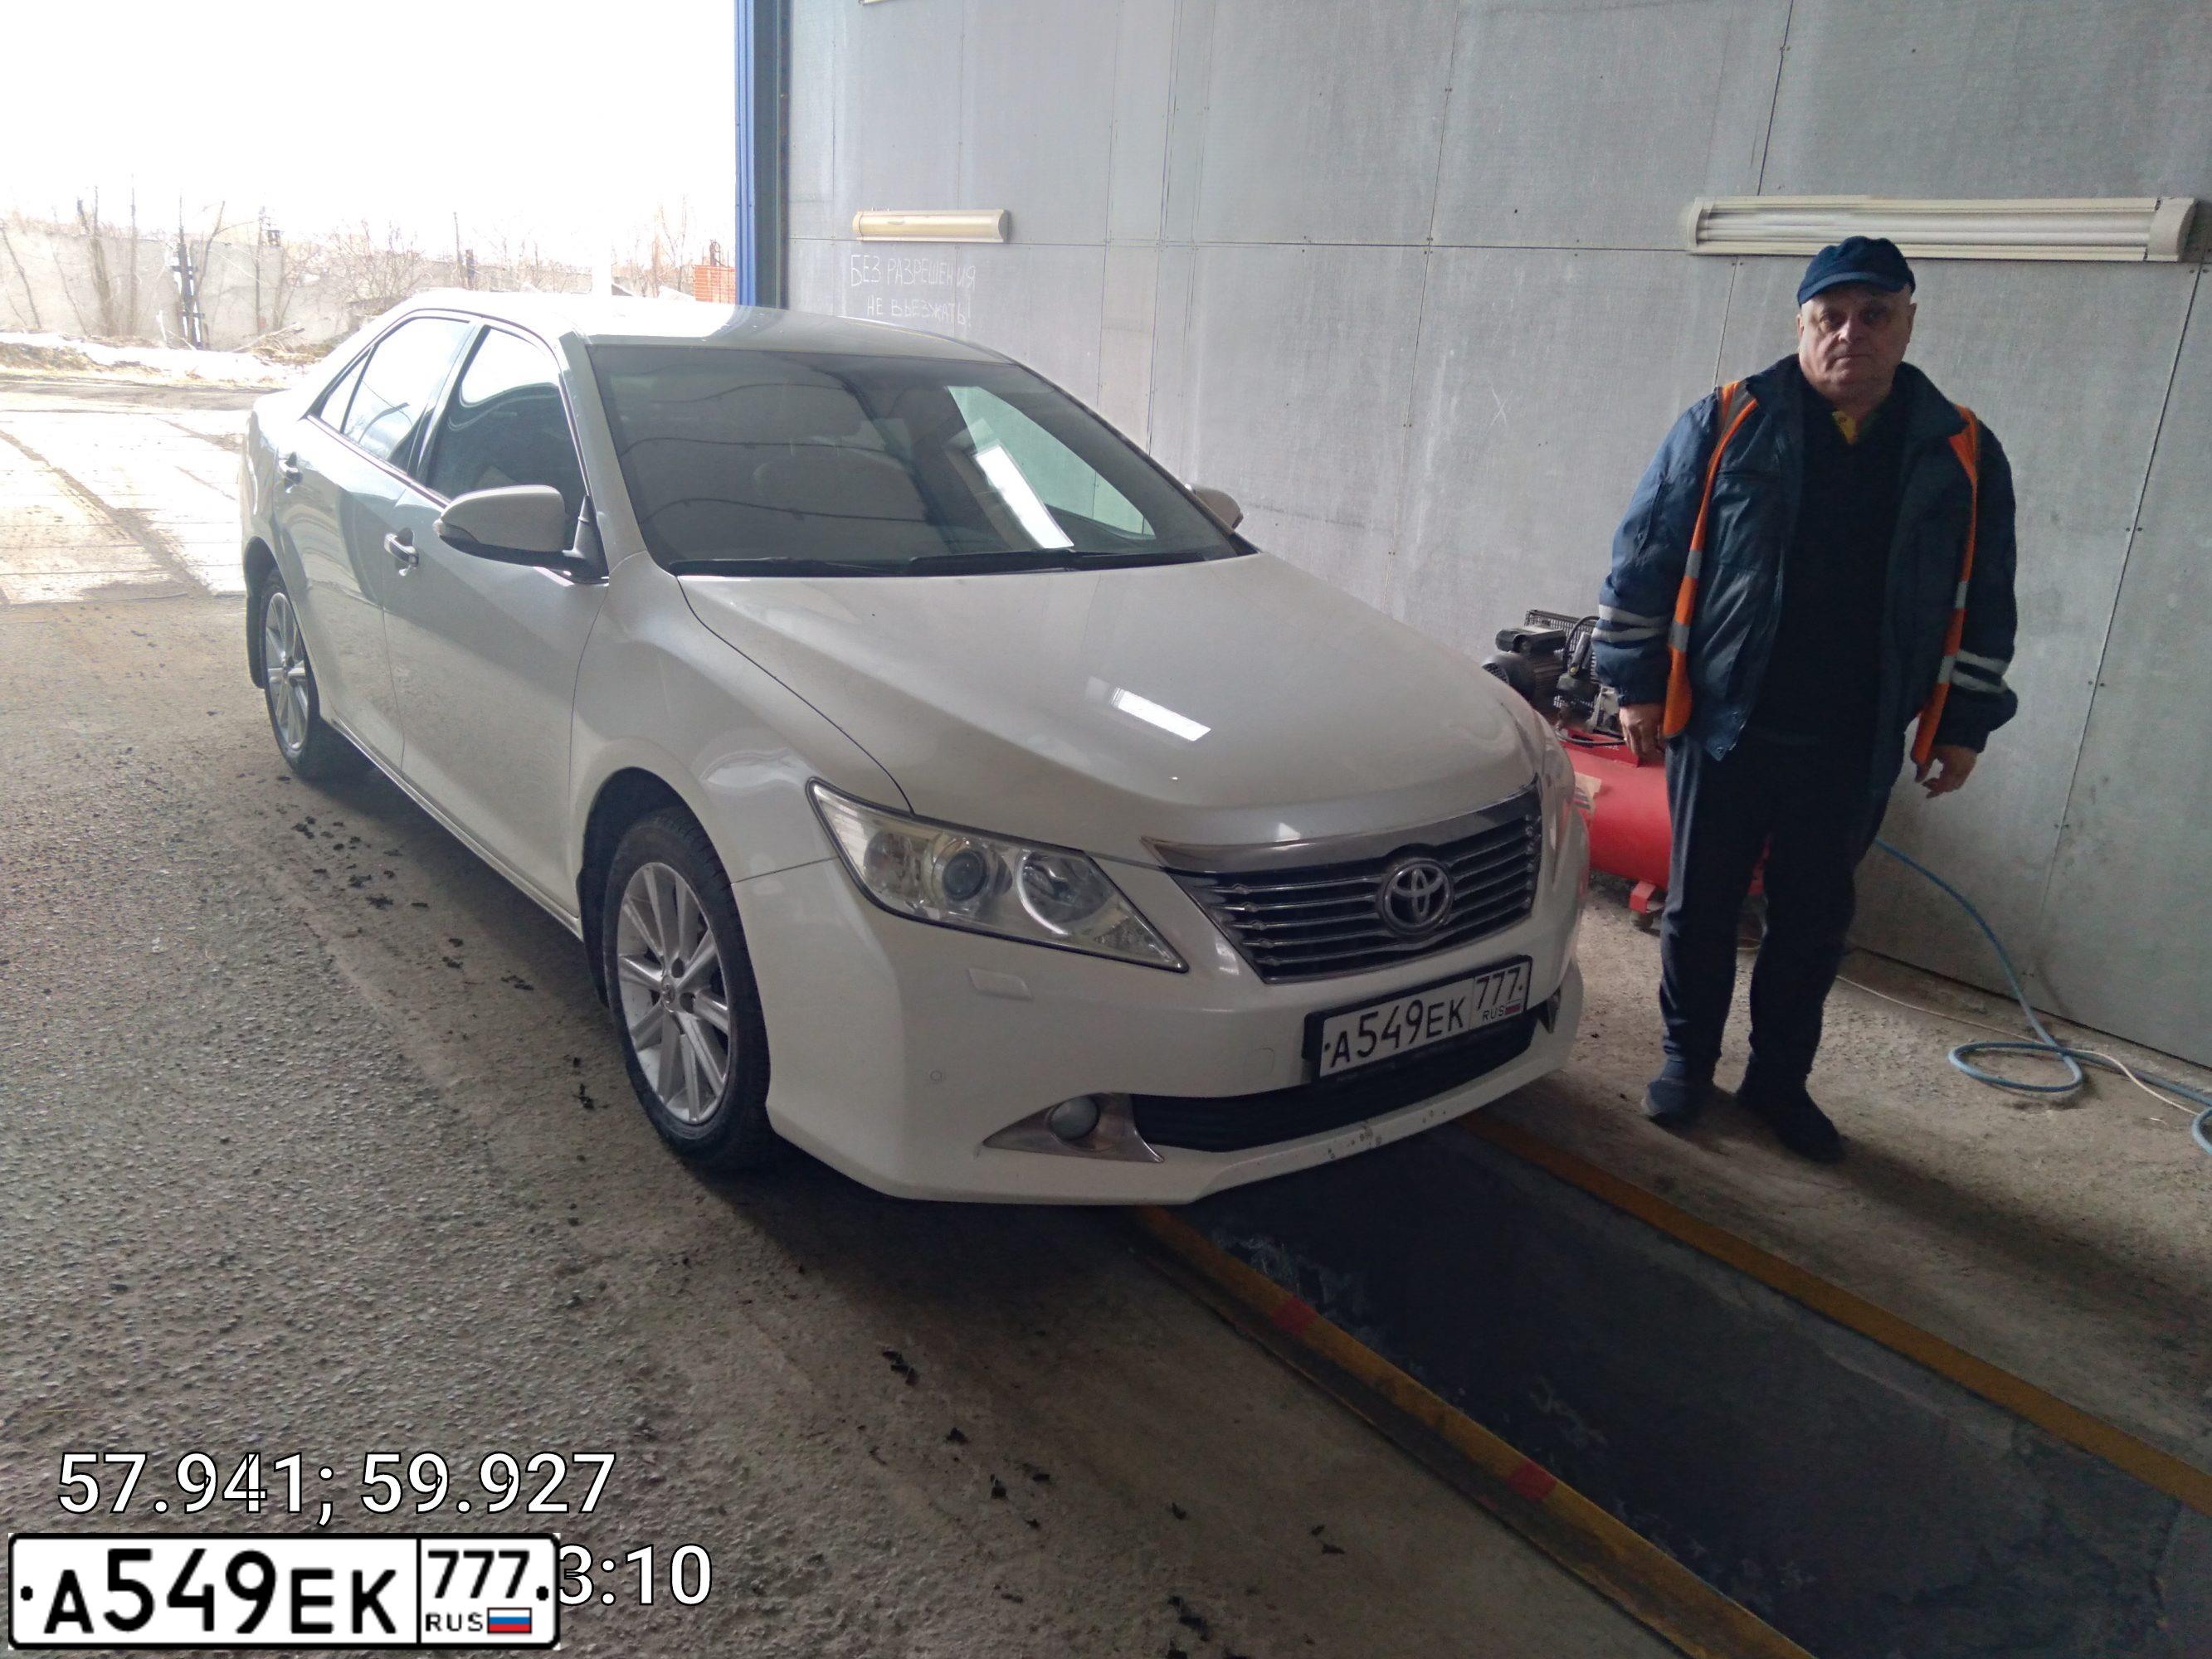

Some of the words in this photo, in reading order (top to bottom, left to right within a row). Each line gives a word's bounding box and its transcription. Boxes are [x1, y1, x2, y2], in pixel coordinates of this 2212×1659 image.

[850, 254, 882, 287] БЕЗ
[887, 257, 977, 290] РАЗРЕШЕНИЯ
[867, 294, 884, 316] НЕ
[1330, 996, 1465, 1068] А549ЕК
[1476, 966, 1522, 1010] 777
[1483, 1007, 1505, 1022] RUS
